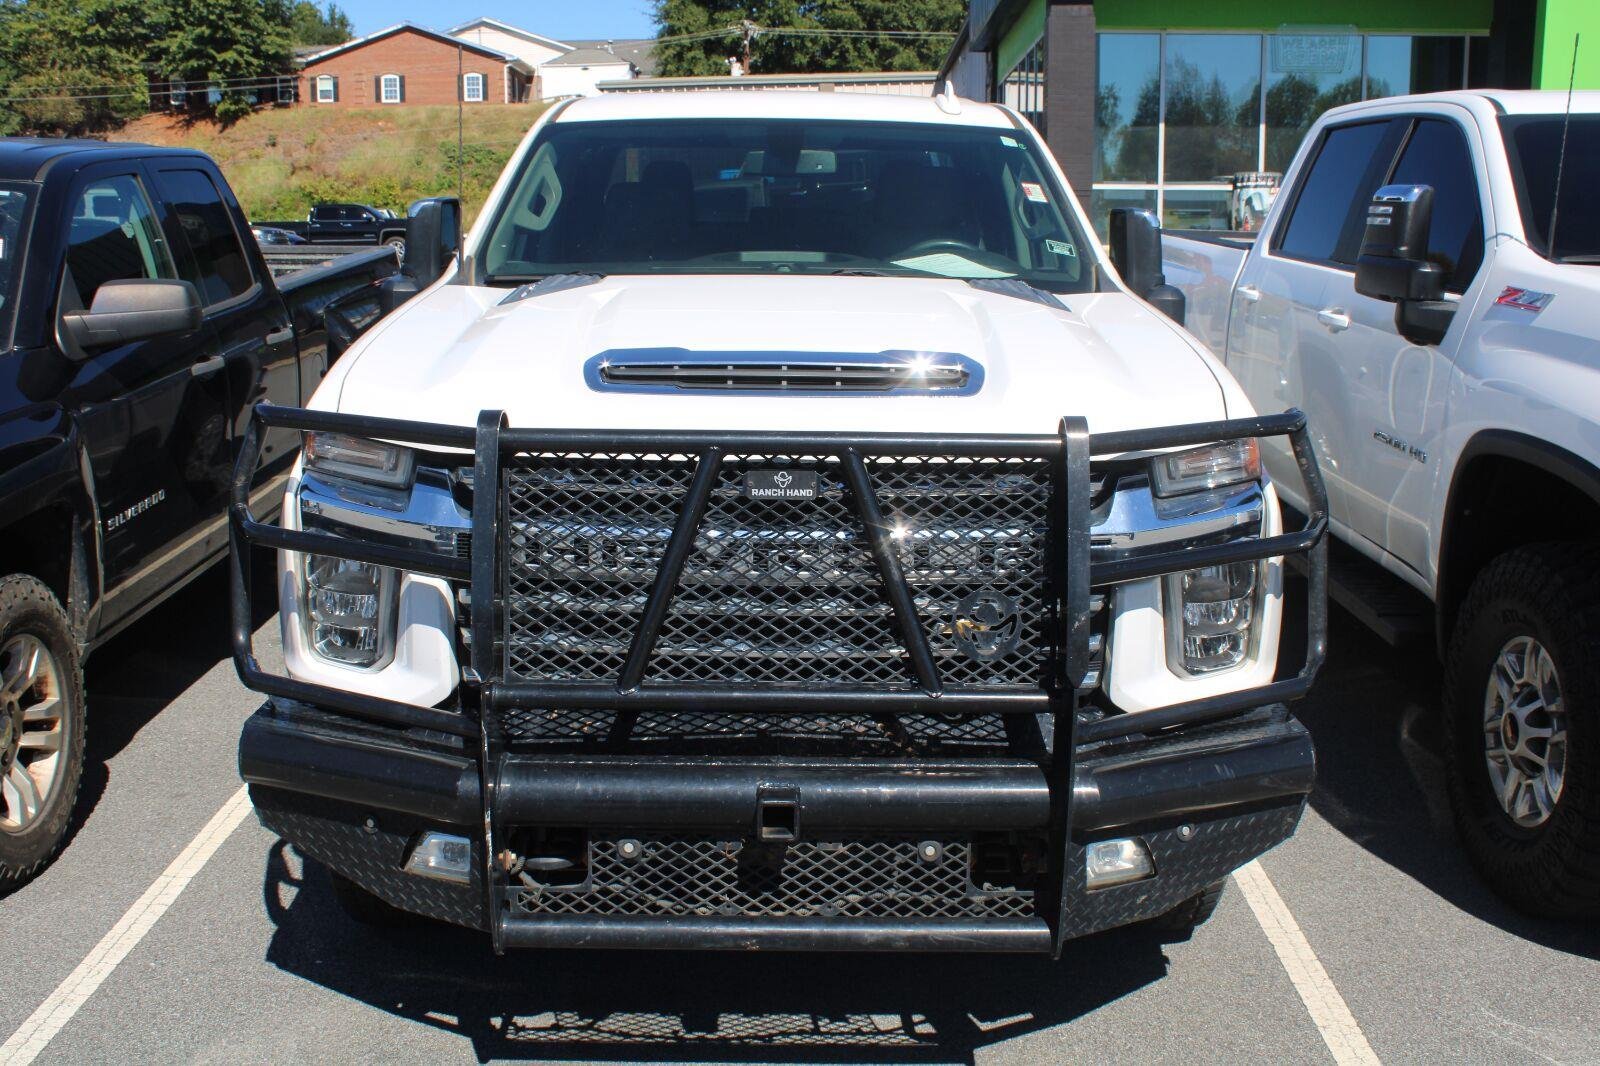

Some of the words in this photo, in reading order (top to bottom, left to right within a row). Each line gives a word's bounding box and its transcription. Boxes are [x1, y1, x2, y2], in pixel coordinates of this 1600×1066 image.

[751, 488, 785, 497] RANCH
[786, 489, 813, 497] HAND
[107, 489, 166, 531] SILVERADO
